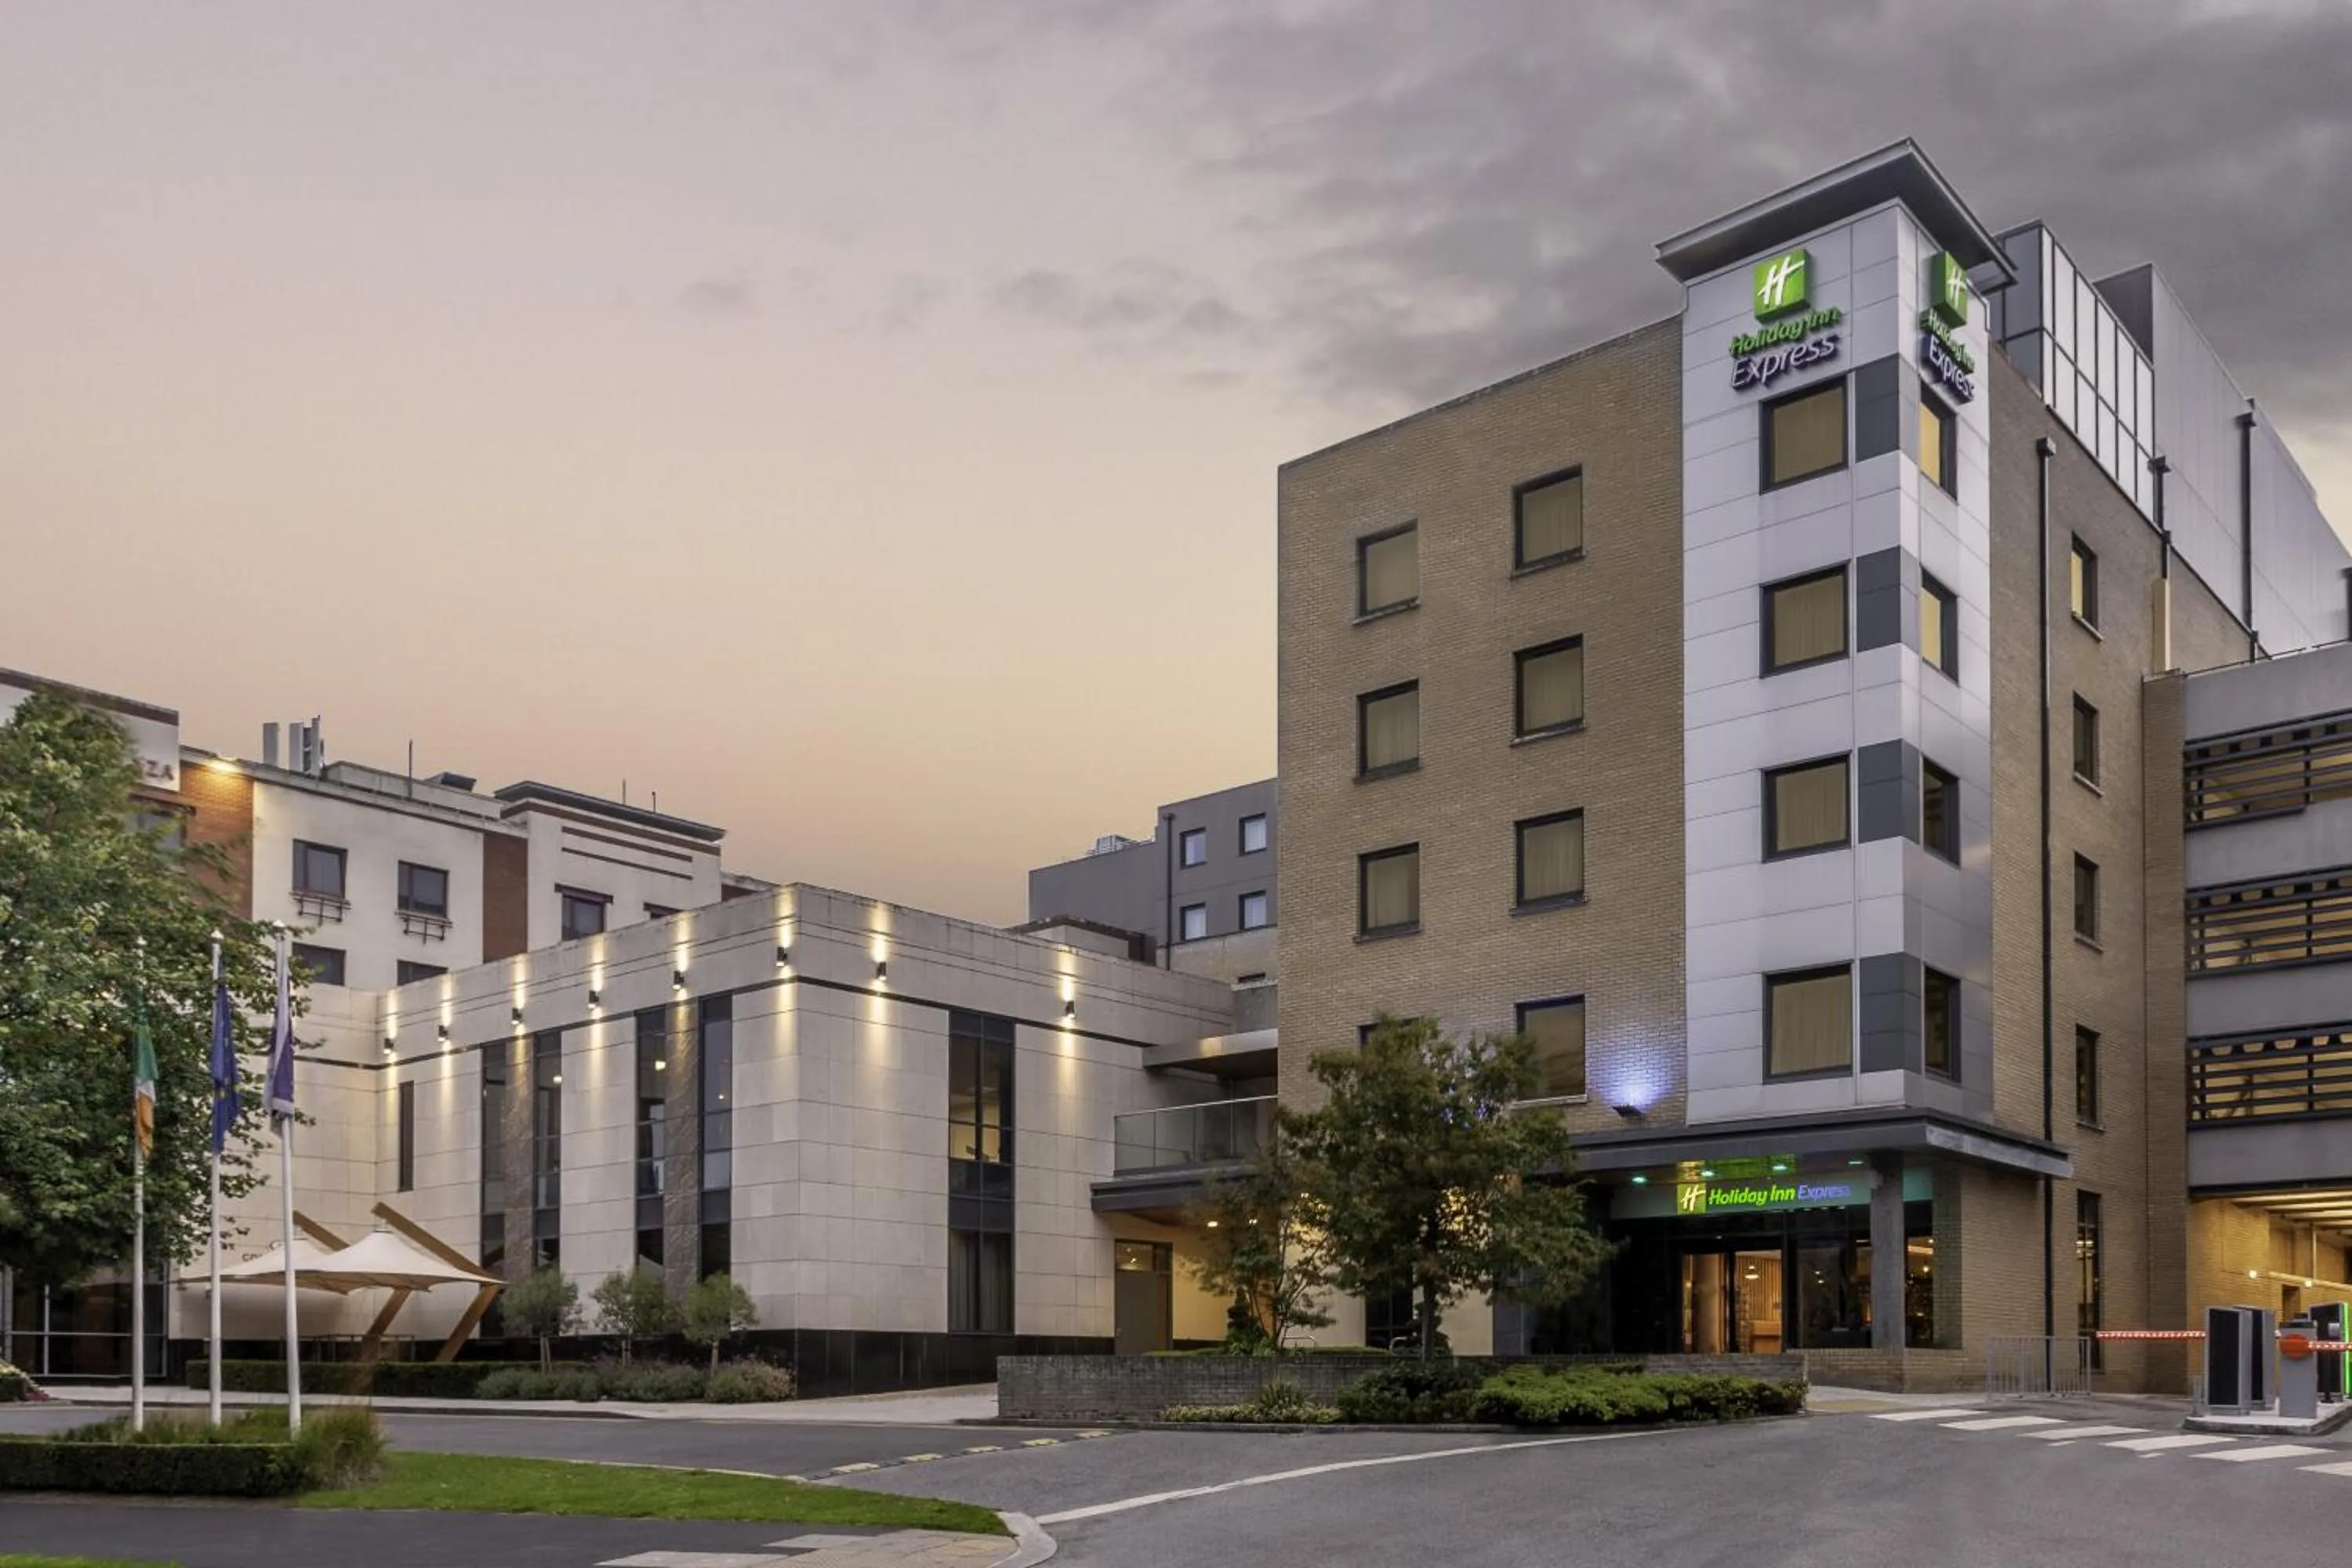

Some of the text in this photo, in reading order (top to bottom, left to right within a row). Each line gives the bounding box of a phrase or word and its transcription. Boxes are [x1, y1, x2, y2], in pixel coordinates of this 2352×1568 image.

[1730, 307, 1840, 357] Holiday Inn
[1732, 332, 1838, 387] Express
[1929, 333, 1975, 401] Express
[1708, 1184, 1850, 1206] Holiday Inn Express
